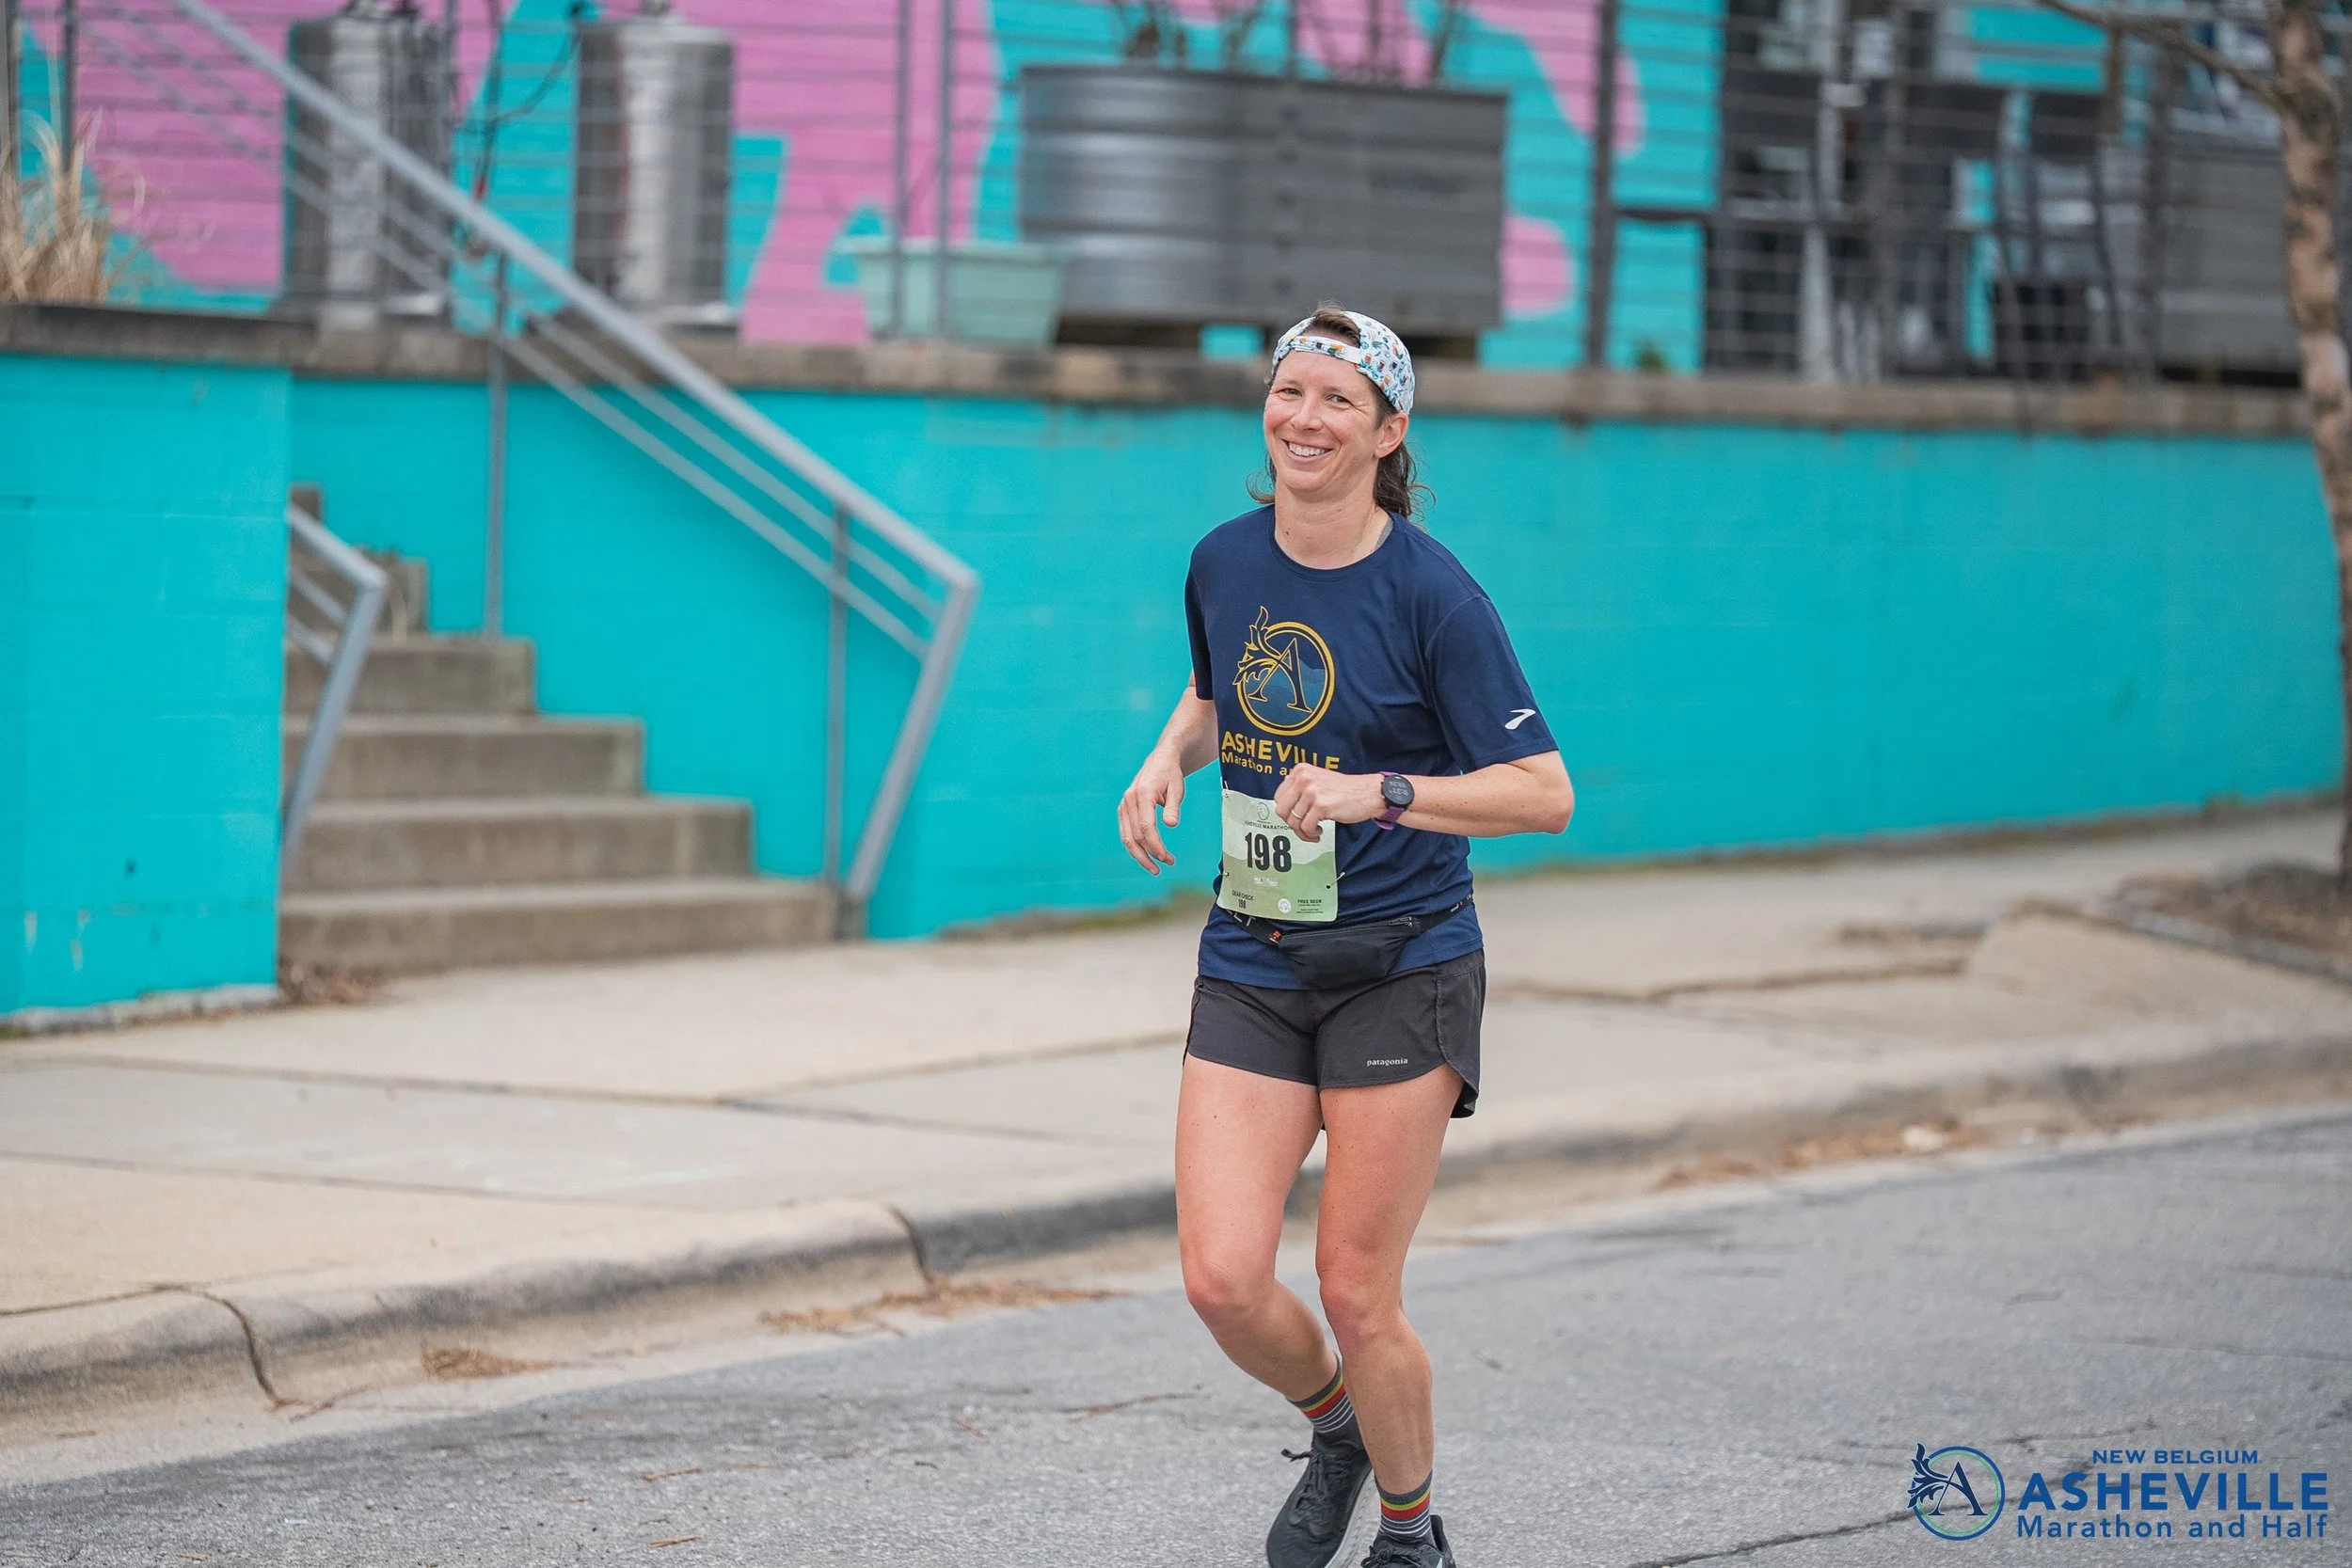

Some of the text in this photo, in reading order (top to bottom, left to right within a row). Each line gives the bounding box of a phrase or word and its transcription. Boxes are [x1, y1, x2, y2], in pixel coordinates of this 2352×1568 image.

[1221, 731, 1340, 769] ASHEVILLE
[1221, 752, 1273, 774] Marathon
[1245, 832, 1292, 873] 198
[1366, 1057, 1408, 1068] patagonia
